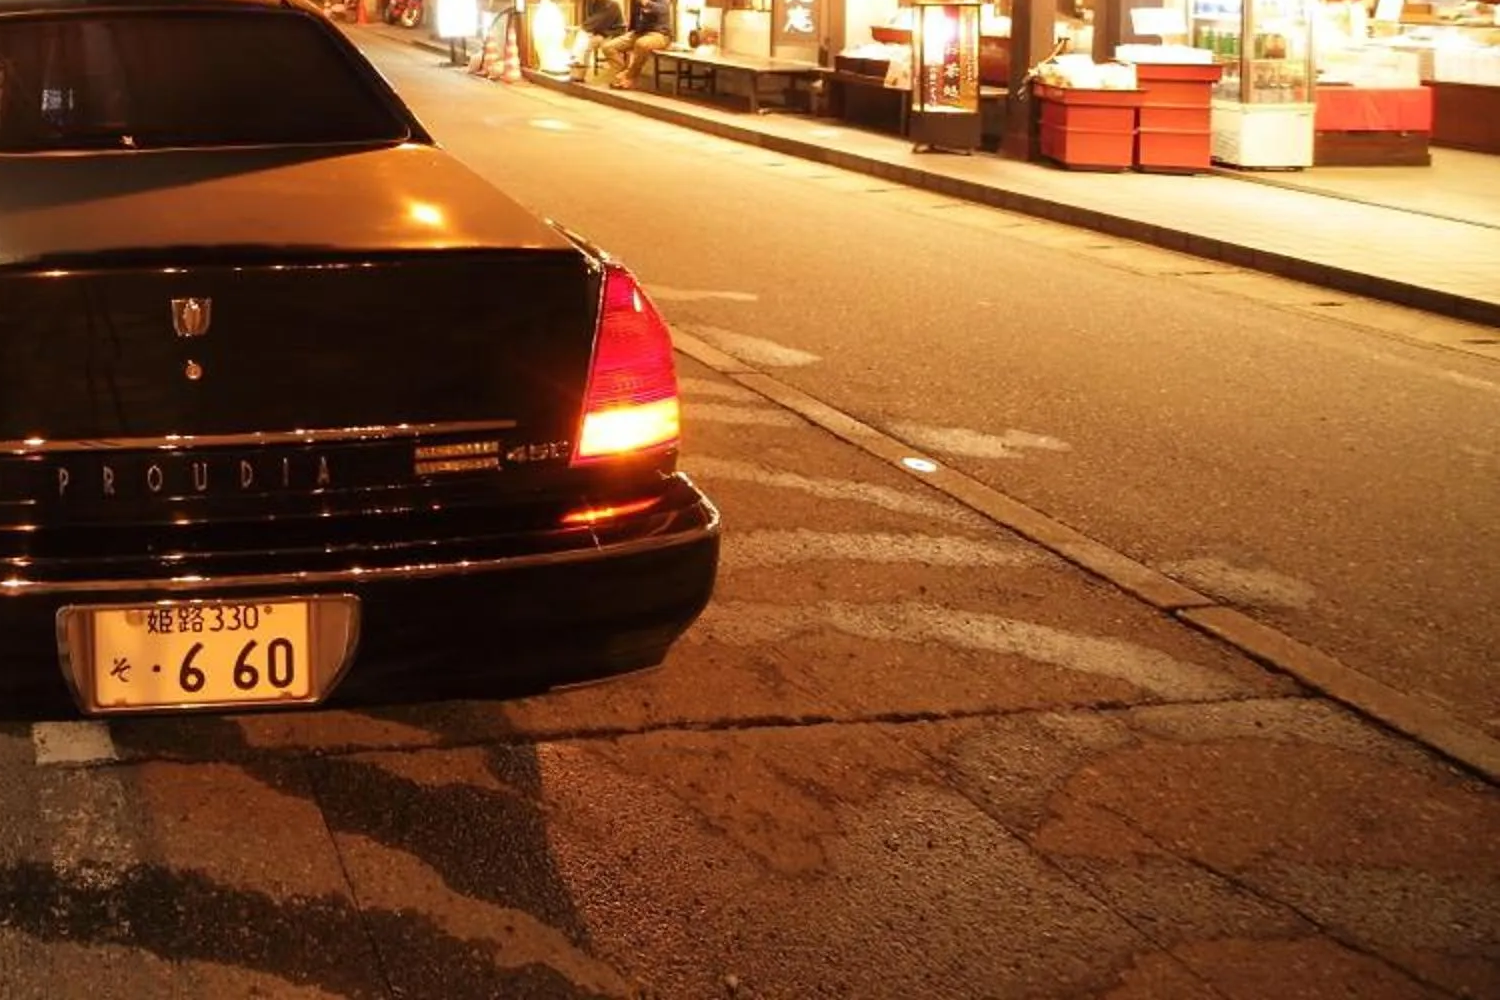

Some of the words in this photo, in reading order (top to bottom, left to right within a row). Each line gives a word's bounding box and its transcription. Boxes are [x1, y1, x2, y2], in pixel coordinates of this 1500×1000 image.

[57, 456, 334, 495] PROUDIA
[147, 606, 260, 634] 姫路330
[110, 657, 132, 683] そ
